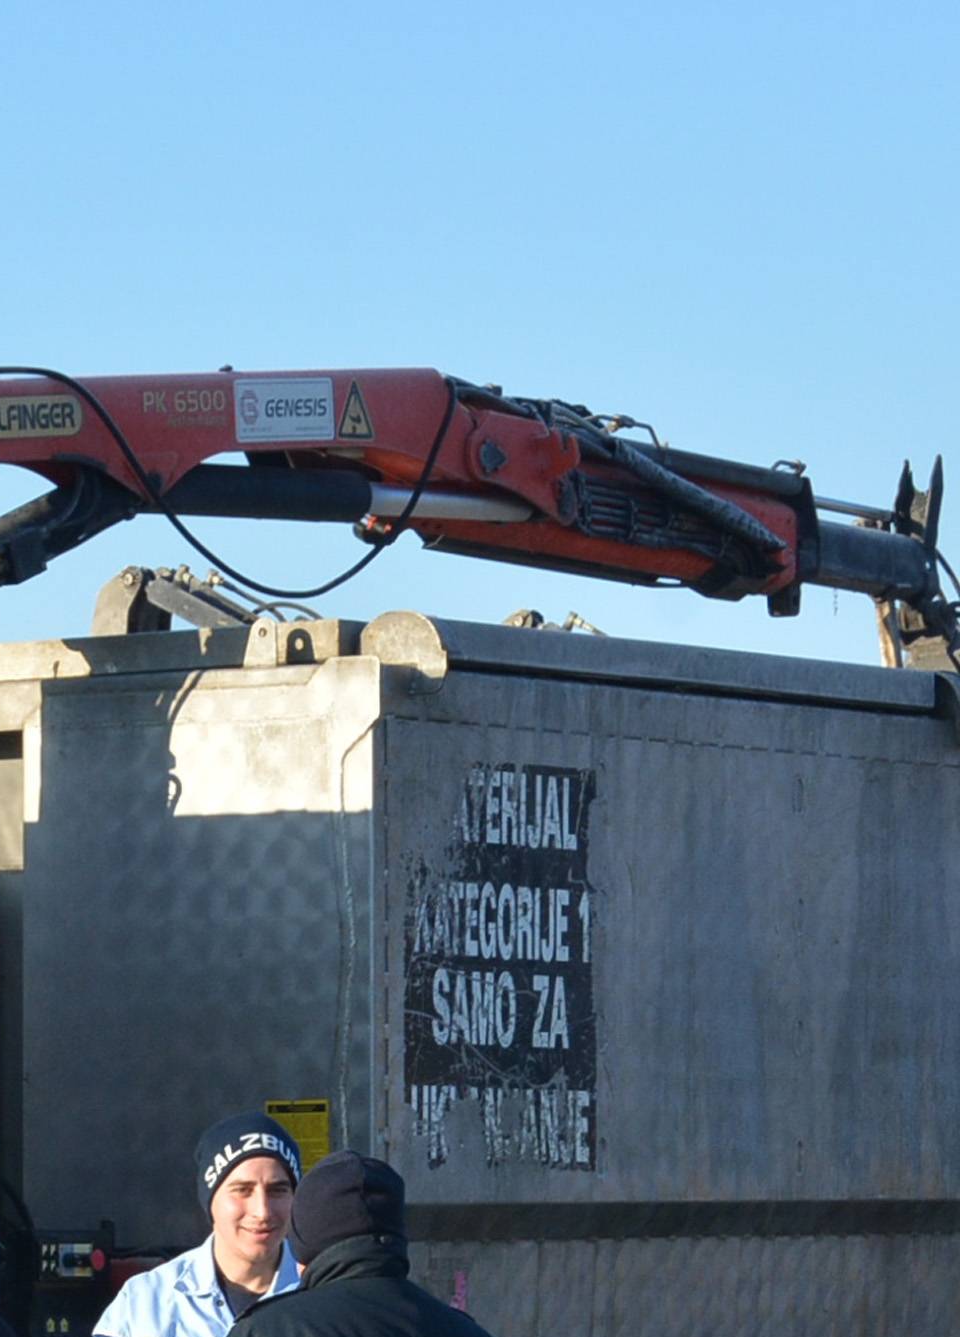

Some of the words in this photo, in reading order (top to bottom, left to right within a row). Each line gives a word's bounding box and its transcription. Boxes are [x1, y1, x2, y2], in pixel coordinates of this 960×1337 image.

[143, 391, 167, 413] PK
[174, 390, 226, 412] 6500
[265, 398, 328, 418] GENESIS
[578, 890, 590, 964] 1
[431, 967, 517, 1049] SAMO
[532, 974, 570, 1050] ZA
[204, 1132, 301, 1189] SALZBUR
